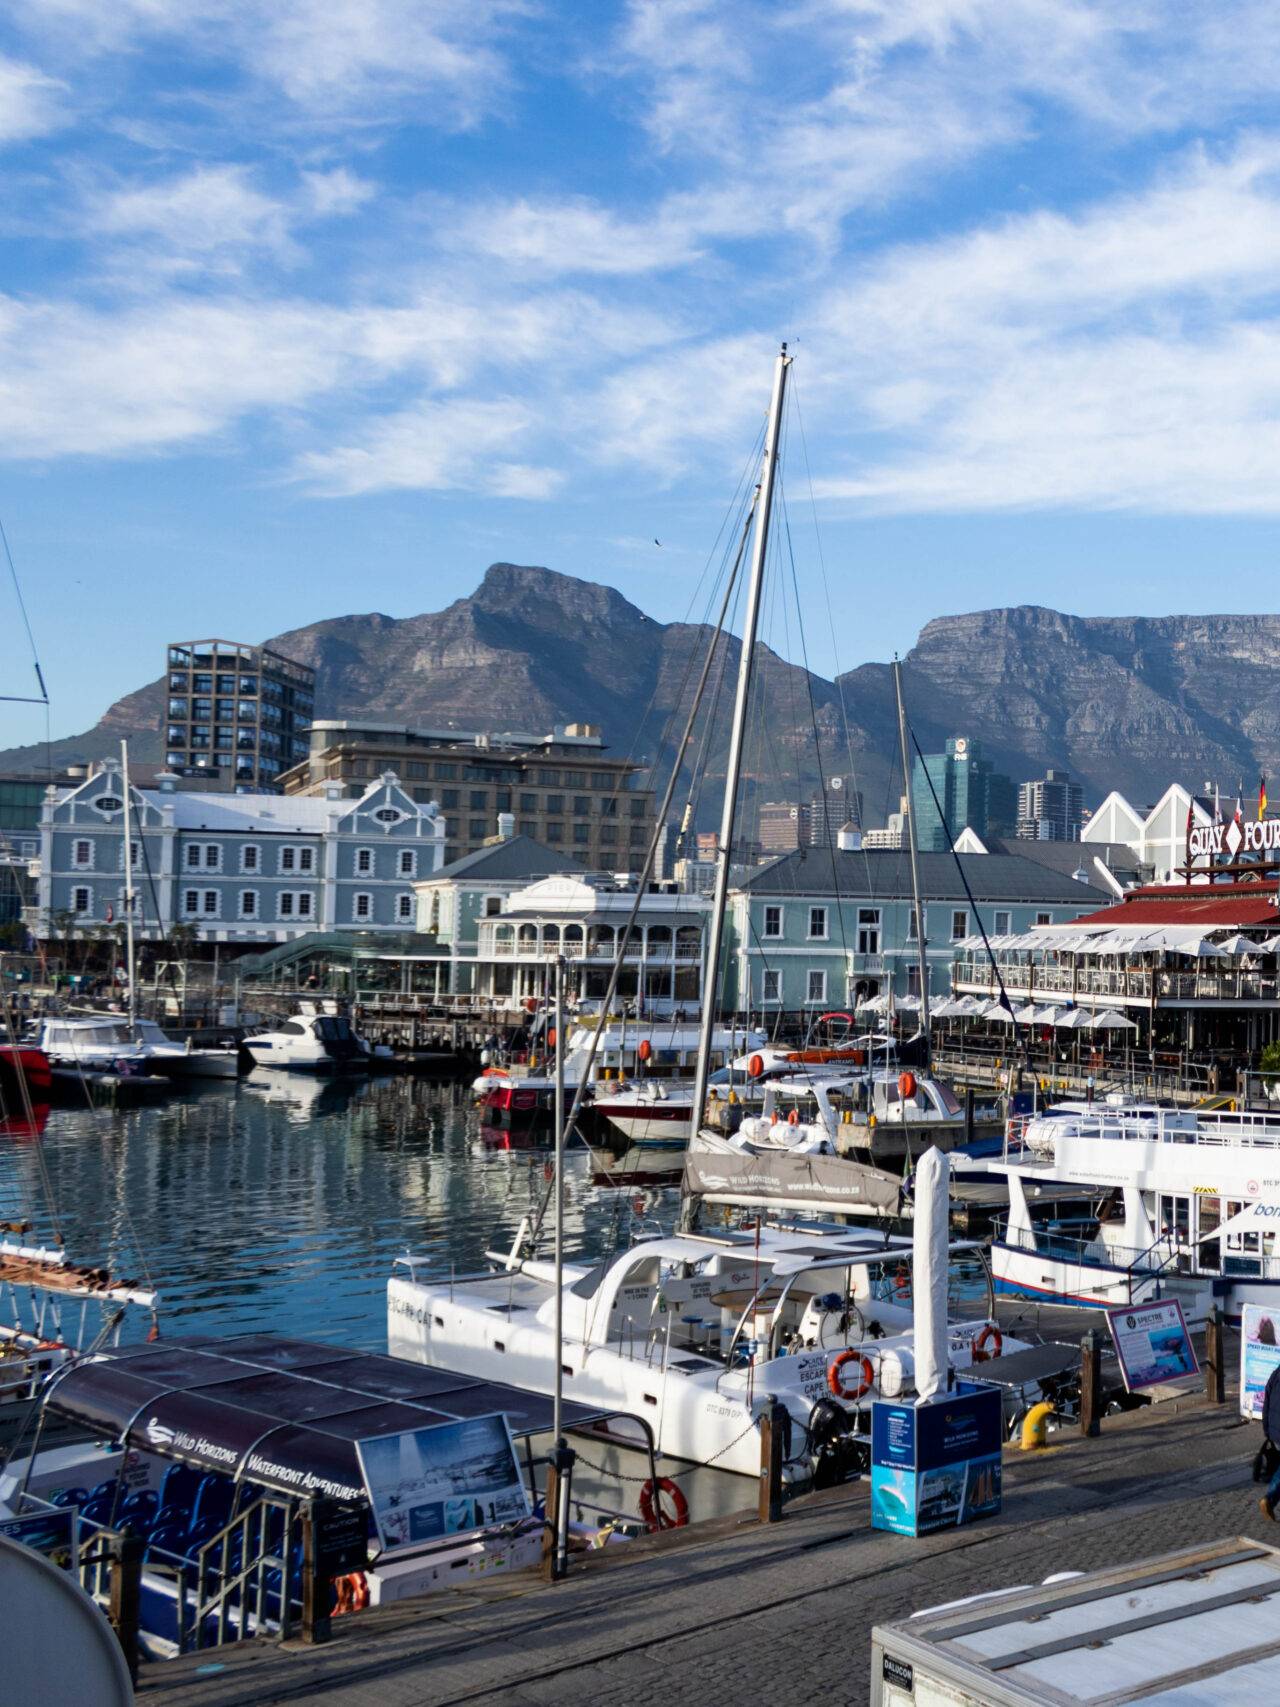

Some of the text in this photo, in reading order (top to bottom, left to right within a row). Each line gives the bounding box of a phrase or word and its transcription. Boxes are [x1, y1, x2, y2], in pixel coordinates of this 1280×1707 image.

[1189, 826, 1223, 855] QUAY
[729, 1175, 747, 1185] WILD
[1137, 1312, 1162, 1324] SPECTRE
[800, 1369, 827, 1382] ESCAP
[804, 1382, 824, 1395] CAPE
[173, 1431, 195, 1451] WILD
[195, 1437, 238, 1464] HORIZONS
[249, 1454, 304, 1486] WATERFRONT
